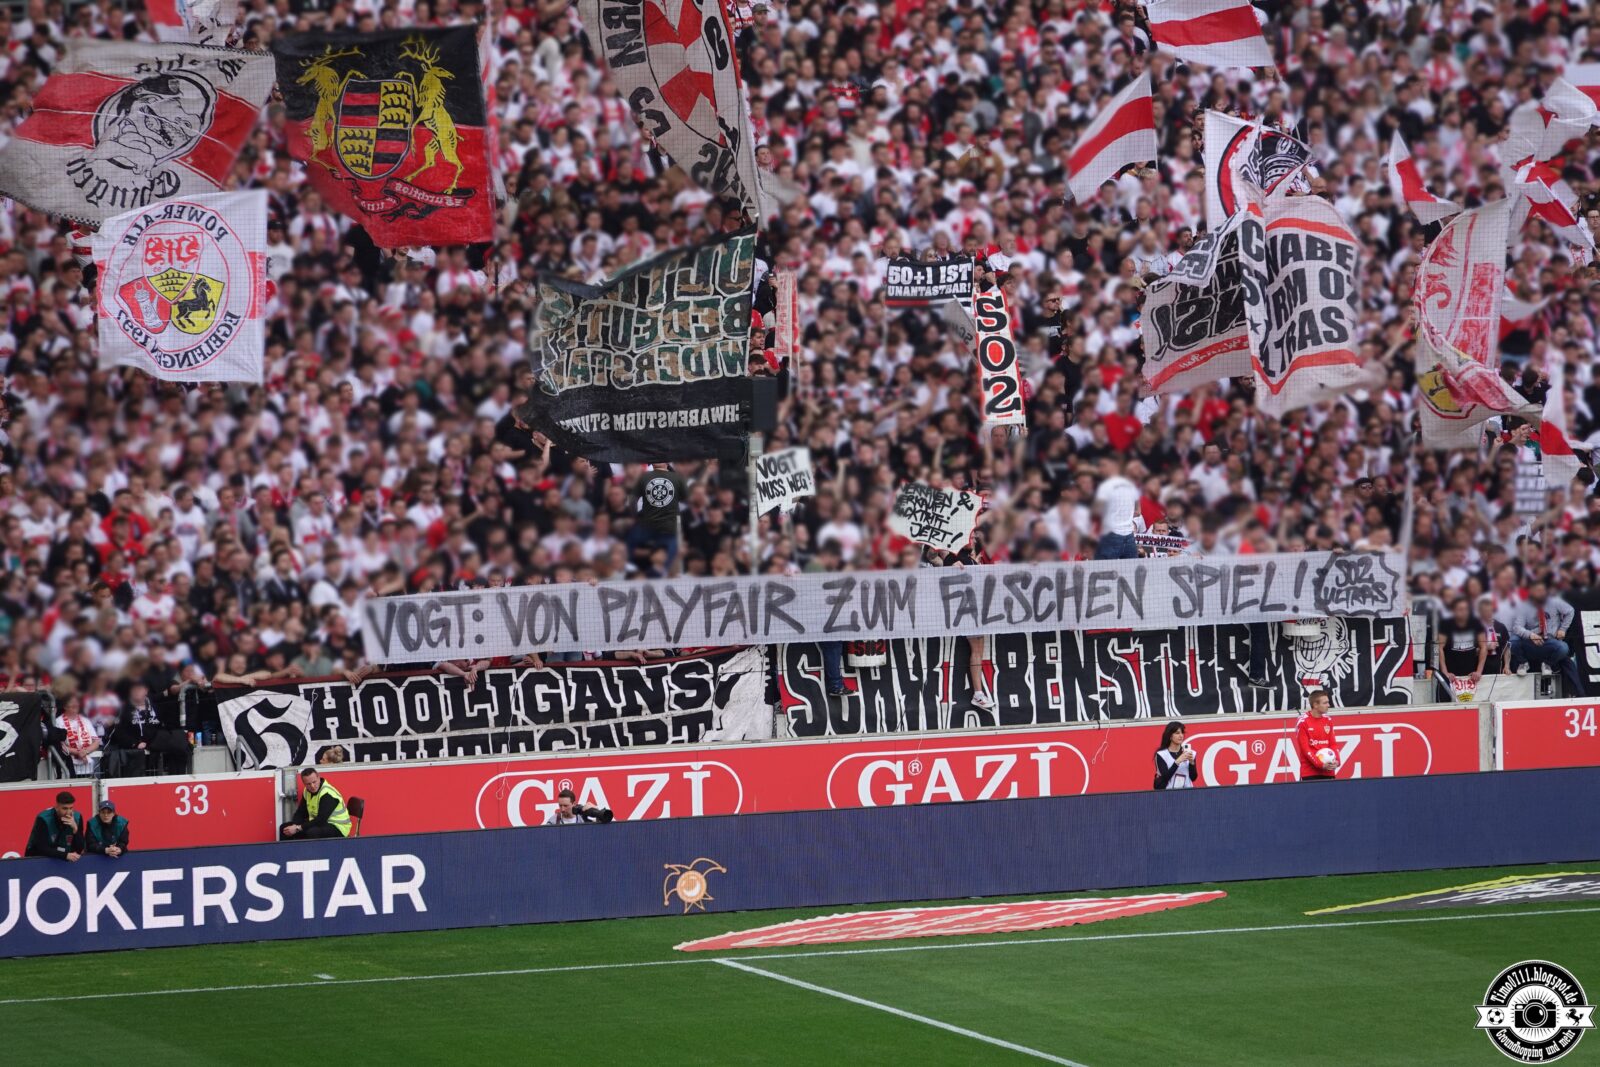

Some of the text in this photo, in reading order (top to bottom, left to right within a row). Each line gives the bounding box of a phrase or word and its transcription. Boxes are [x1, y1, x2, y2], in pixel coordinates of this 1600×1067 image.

[887, 263, 973, 285] 50+1 IST
[887, 282, 972, 297] UNANTASTBAR!
[757, 450, 798, 479] VOGT
[757, 470, 812, 502] MUSS WEG!
[957, 491, 974, 511] &
[366, 559, 1309, 658] VOGT: VON PLAYFAIR ZUM FALSCHEN SPIEL!
[302, 657, 714, 742] HOOLIGANS
[1564, 707, 1598, 738] 34
[174, 784, 210, 816] 33
[0, 853, 428, 938] JOKERSTAR
